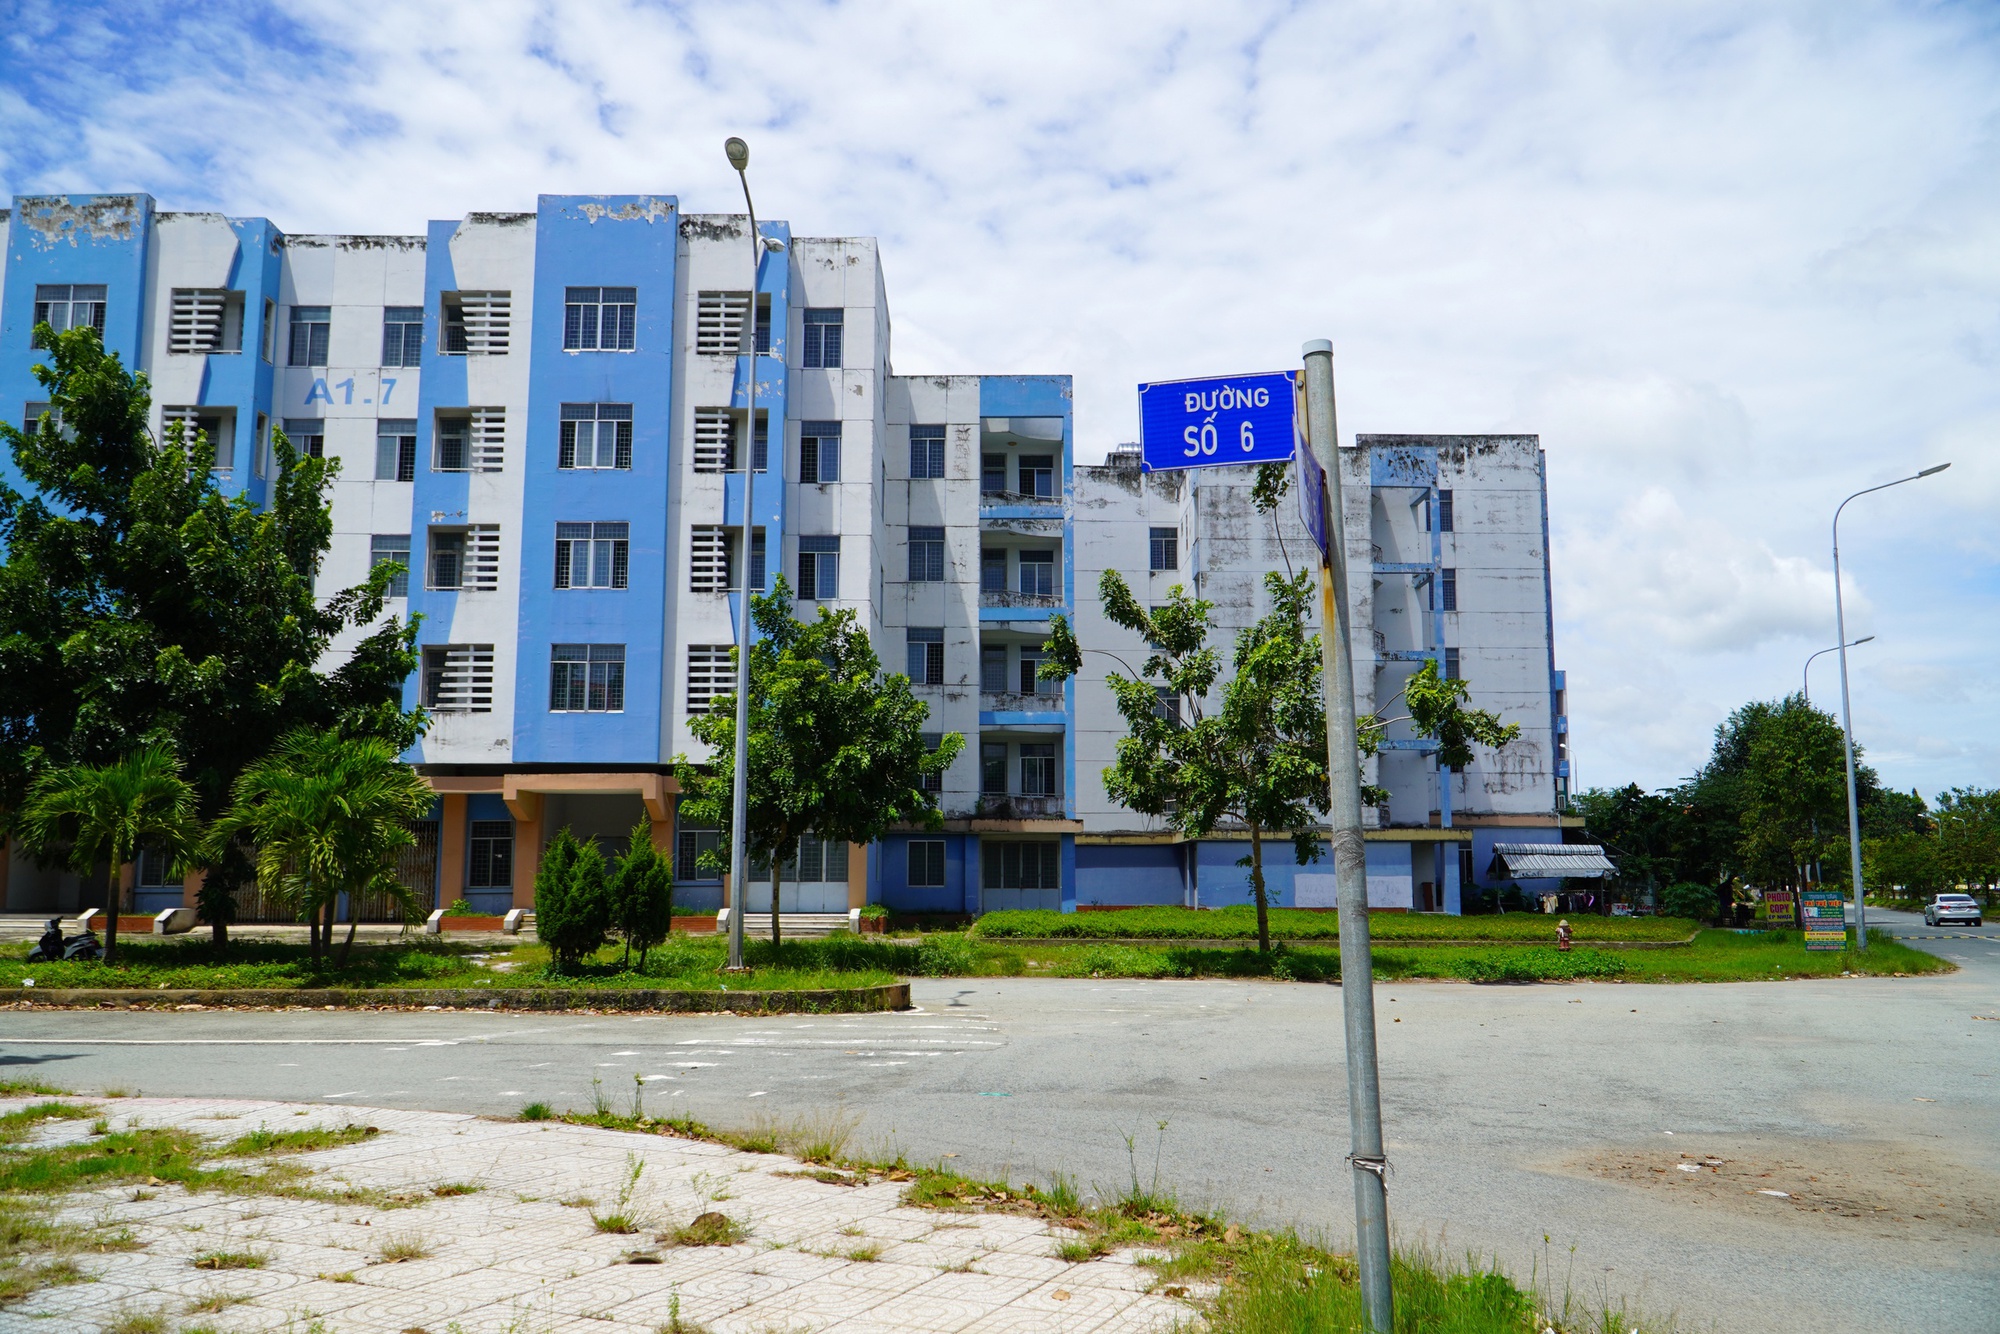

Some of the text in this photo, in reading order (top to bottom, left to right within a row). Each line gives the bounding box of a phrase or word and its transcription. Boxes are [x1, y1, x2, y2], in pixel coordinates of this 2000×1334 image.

[303, 377, 397, 405] A1.7
[1184, 385, 1269, 413] ĐƯỜNG
[1183, 411, 1254, 457] SỐ 6
[1766, 892, 1790, 902] PHOTO
[1770, 904, 1789, 913] COPY
